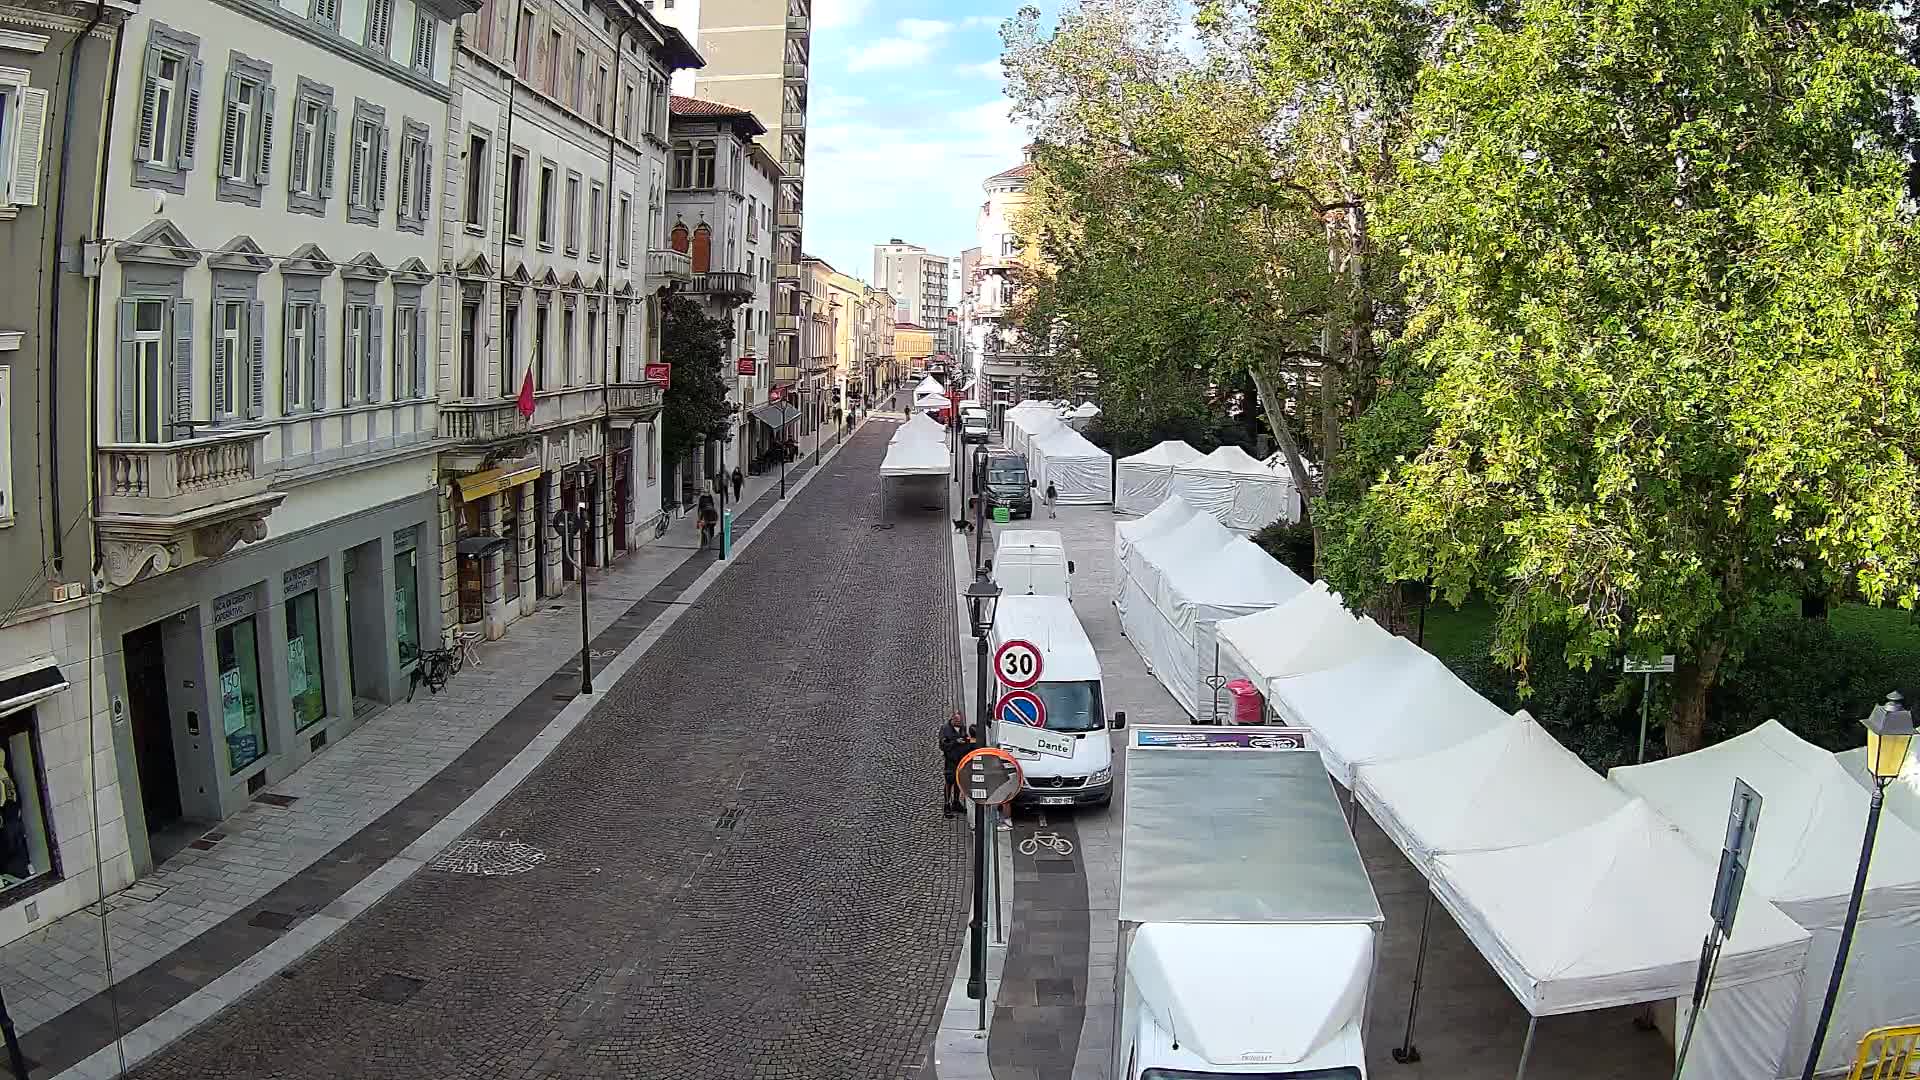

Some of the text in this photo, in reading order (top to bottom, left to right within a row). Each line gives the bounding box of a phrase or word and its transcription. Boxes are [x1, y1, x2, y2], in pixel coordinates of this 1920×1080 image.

[1005, 653, 1033, 675] 30
[221, 671, 241, 694] 130
[1037, 739, 1069, 753] Dante
